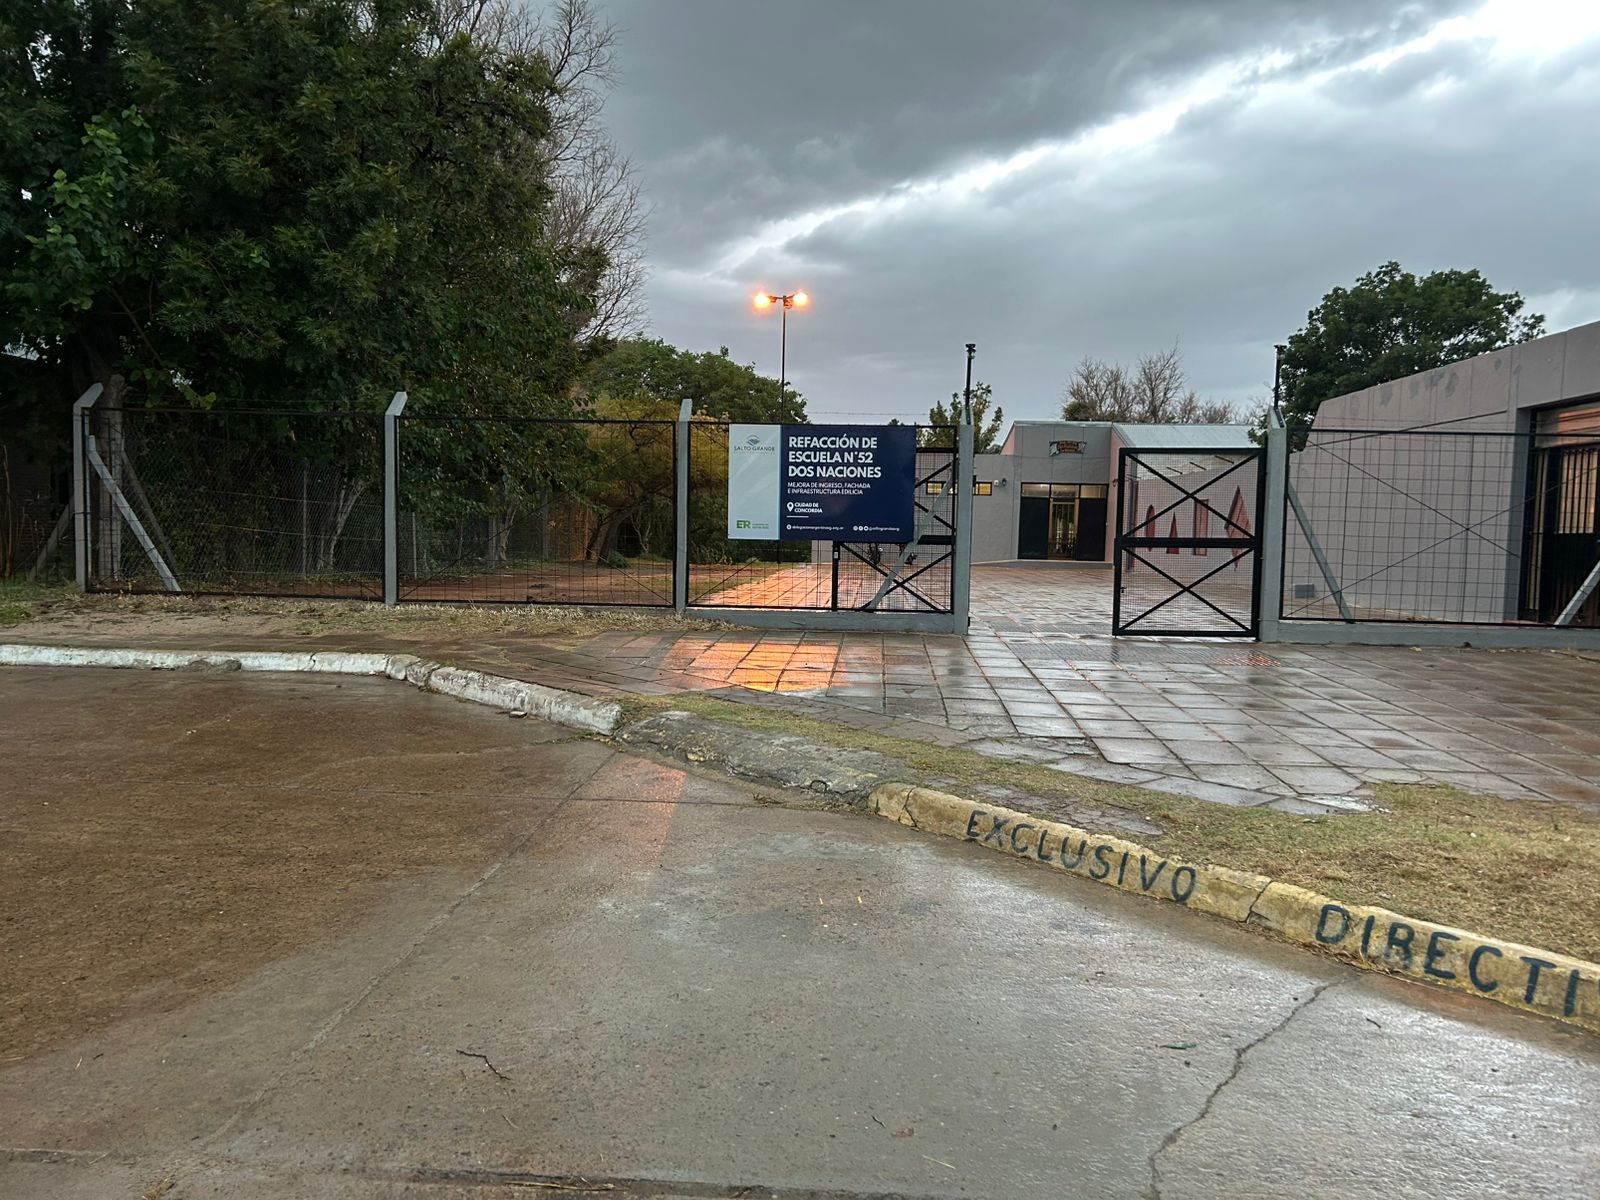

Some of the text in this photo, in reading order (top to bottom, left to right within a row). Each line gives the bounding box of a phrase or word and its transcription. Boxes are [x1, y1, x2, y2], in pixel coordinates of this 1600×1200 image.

[789, 433, 878, 448] REFACCIÓN DE
[788, 451, 842, 463] ESCUELA
[788, 465, 882, 478] DOS NACIONES
[736, 520, 751, 529] ER
[966, 809, 1600, 1017] EXCLUSIVO DIRECTI
